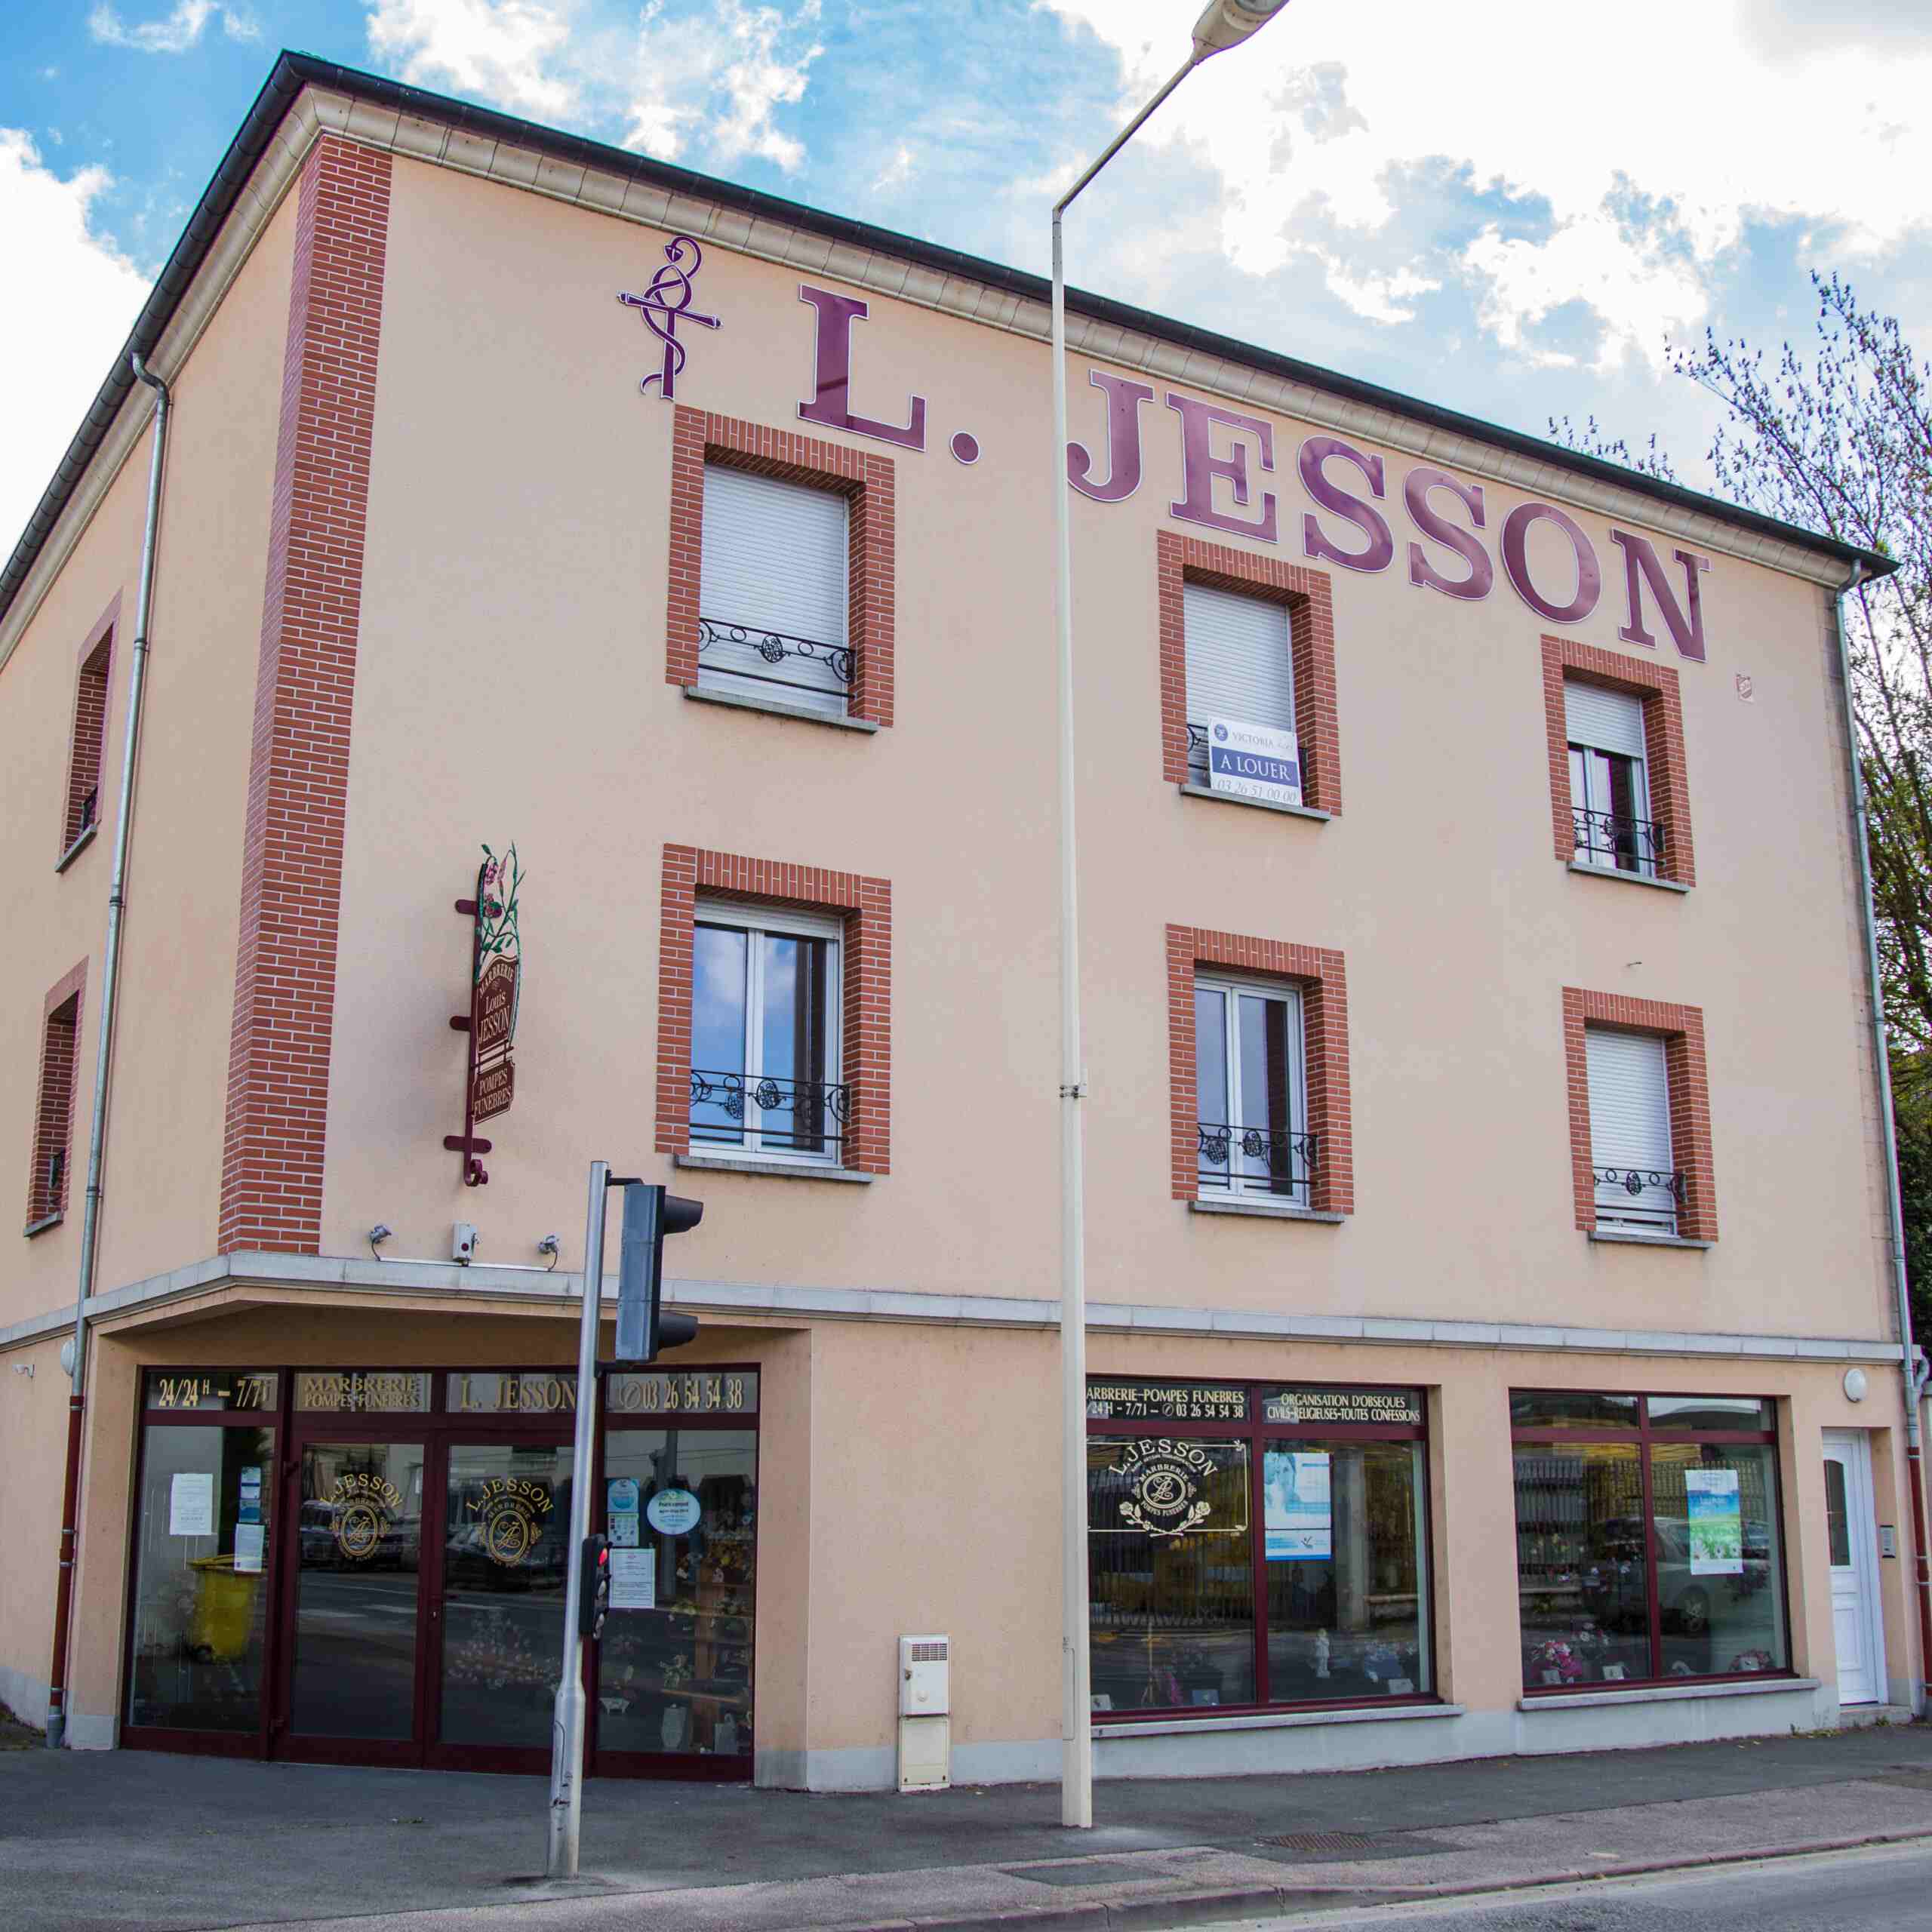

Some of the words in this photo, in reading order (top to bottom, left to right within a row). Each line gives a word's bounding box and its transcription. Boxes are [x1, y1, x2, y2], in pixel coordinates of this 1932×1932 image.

[797, 283, 980, 465] L.
[1066, 368, 1712, 663] JESSON
[1232, 732, 1274, 749] VICTORIA
[1221, 754, 1232, 770] A
[1237, 755, 1291, 781] LOUER
[479, 963, 513, 998] MARBRERIE
[485, 989, 506, 1015] Louis
[478, 1005, 509, 1044] JESSON
[479, 1068, 507, 1096] POMPES
[305, 1377, 421, 1392] MARBRERIE
[495, 1377, 578, 1410] JESSON
[643, 1381, 659, 1409] 03
[663, 1380, 678, 1409] 26
[684, 1380, 700, 1409] 54
[705, 1380, 721, 1409] 54
[726, 1379, 743, 1409] 38
[304, 1394, 352, 1407] POMPES
[357, 1394, 420, 1407] FUNEBRES
[1192, 1390, 1244, 1404] FUNEBRES
[1280, 1393, 1349, 1407] ORGANISATION
[1352, 1395, 1405, 1409] D'OBSEQUES
[1176, 1404, 1187, 1417] 03
[1190, 1404, 1201, 1417] 26
[1205, 1404, 1216, 1418] 54
[1219, 1404, 1229, 1418] 54
[1232, 1405, 1244, 1419] 38
[1371, 1408, 1420, 1422] CONFESSIONS
[1139, 1463, 1189, 1483] MARBRERIE
